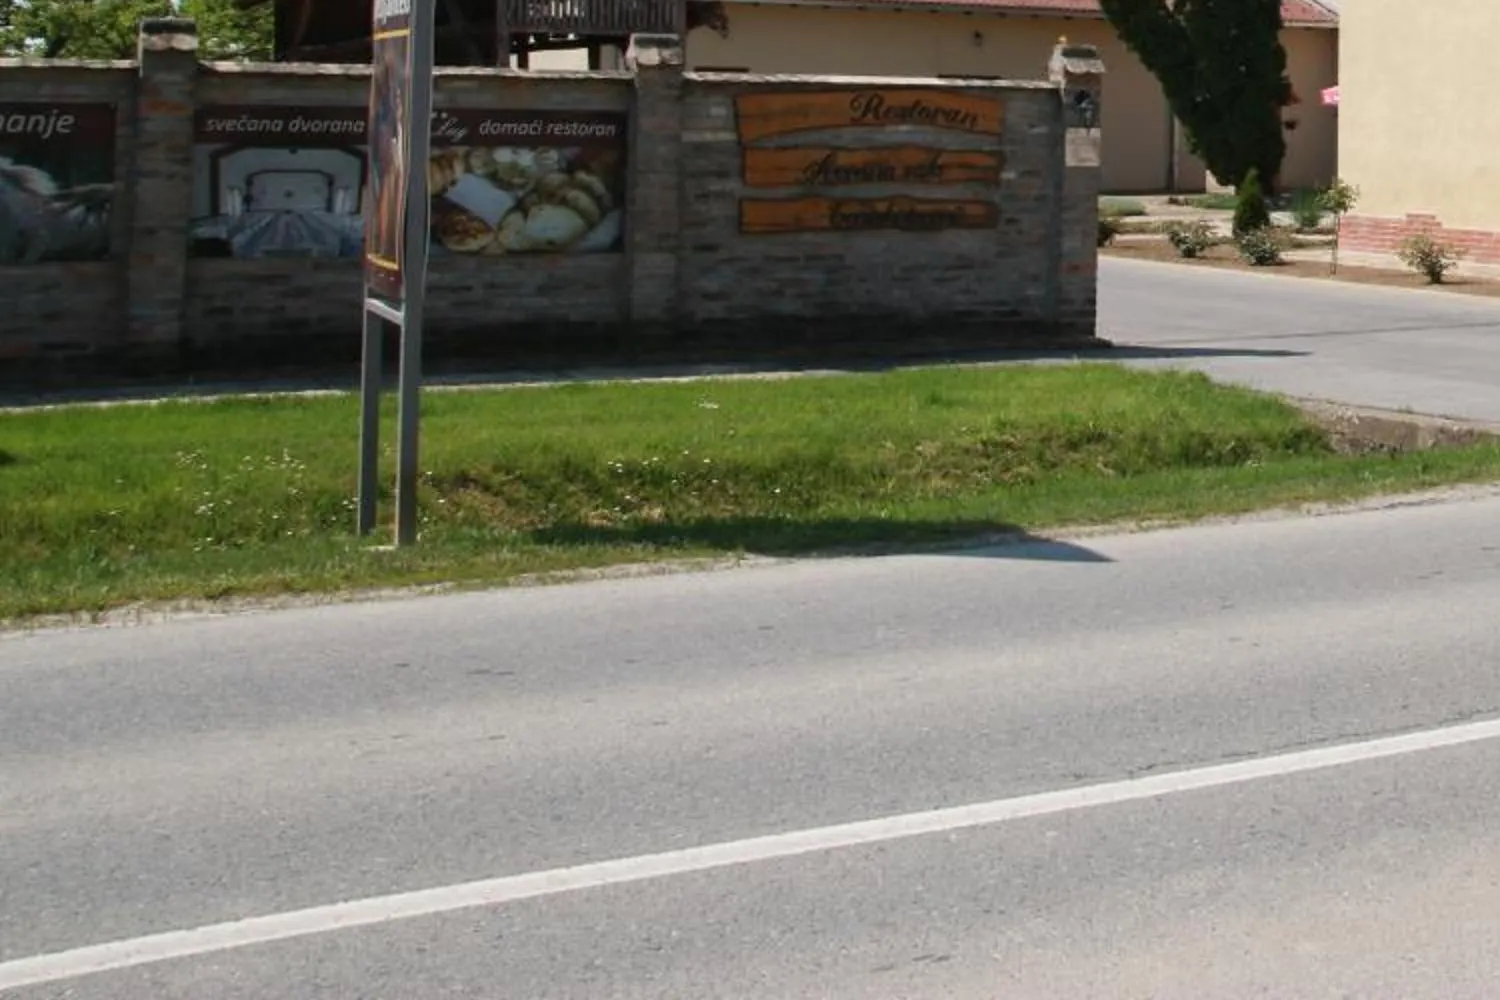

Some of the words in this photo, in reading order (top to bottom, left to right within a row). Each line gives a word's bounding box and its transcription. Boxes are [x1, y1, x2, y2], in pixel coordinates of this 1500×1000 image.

[849, 92, 979, 131] Restoran
[205, 114, 282, 134] svečana
[288, 114, 365, 134] dvorana
[546, 119, 617, 138] restoran
